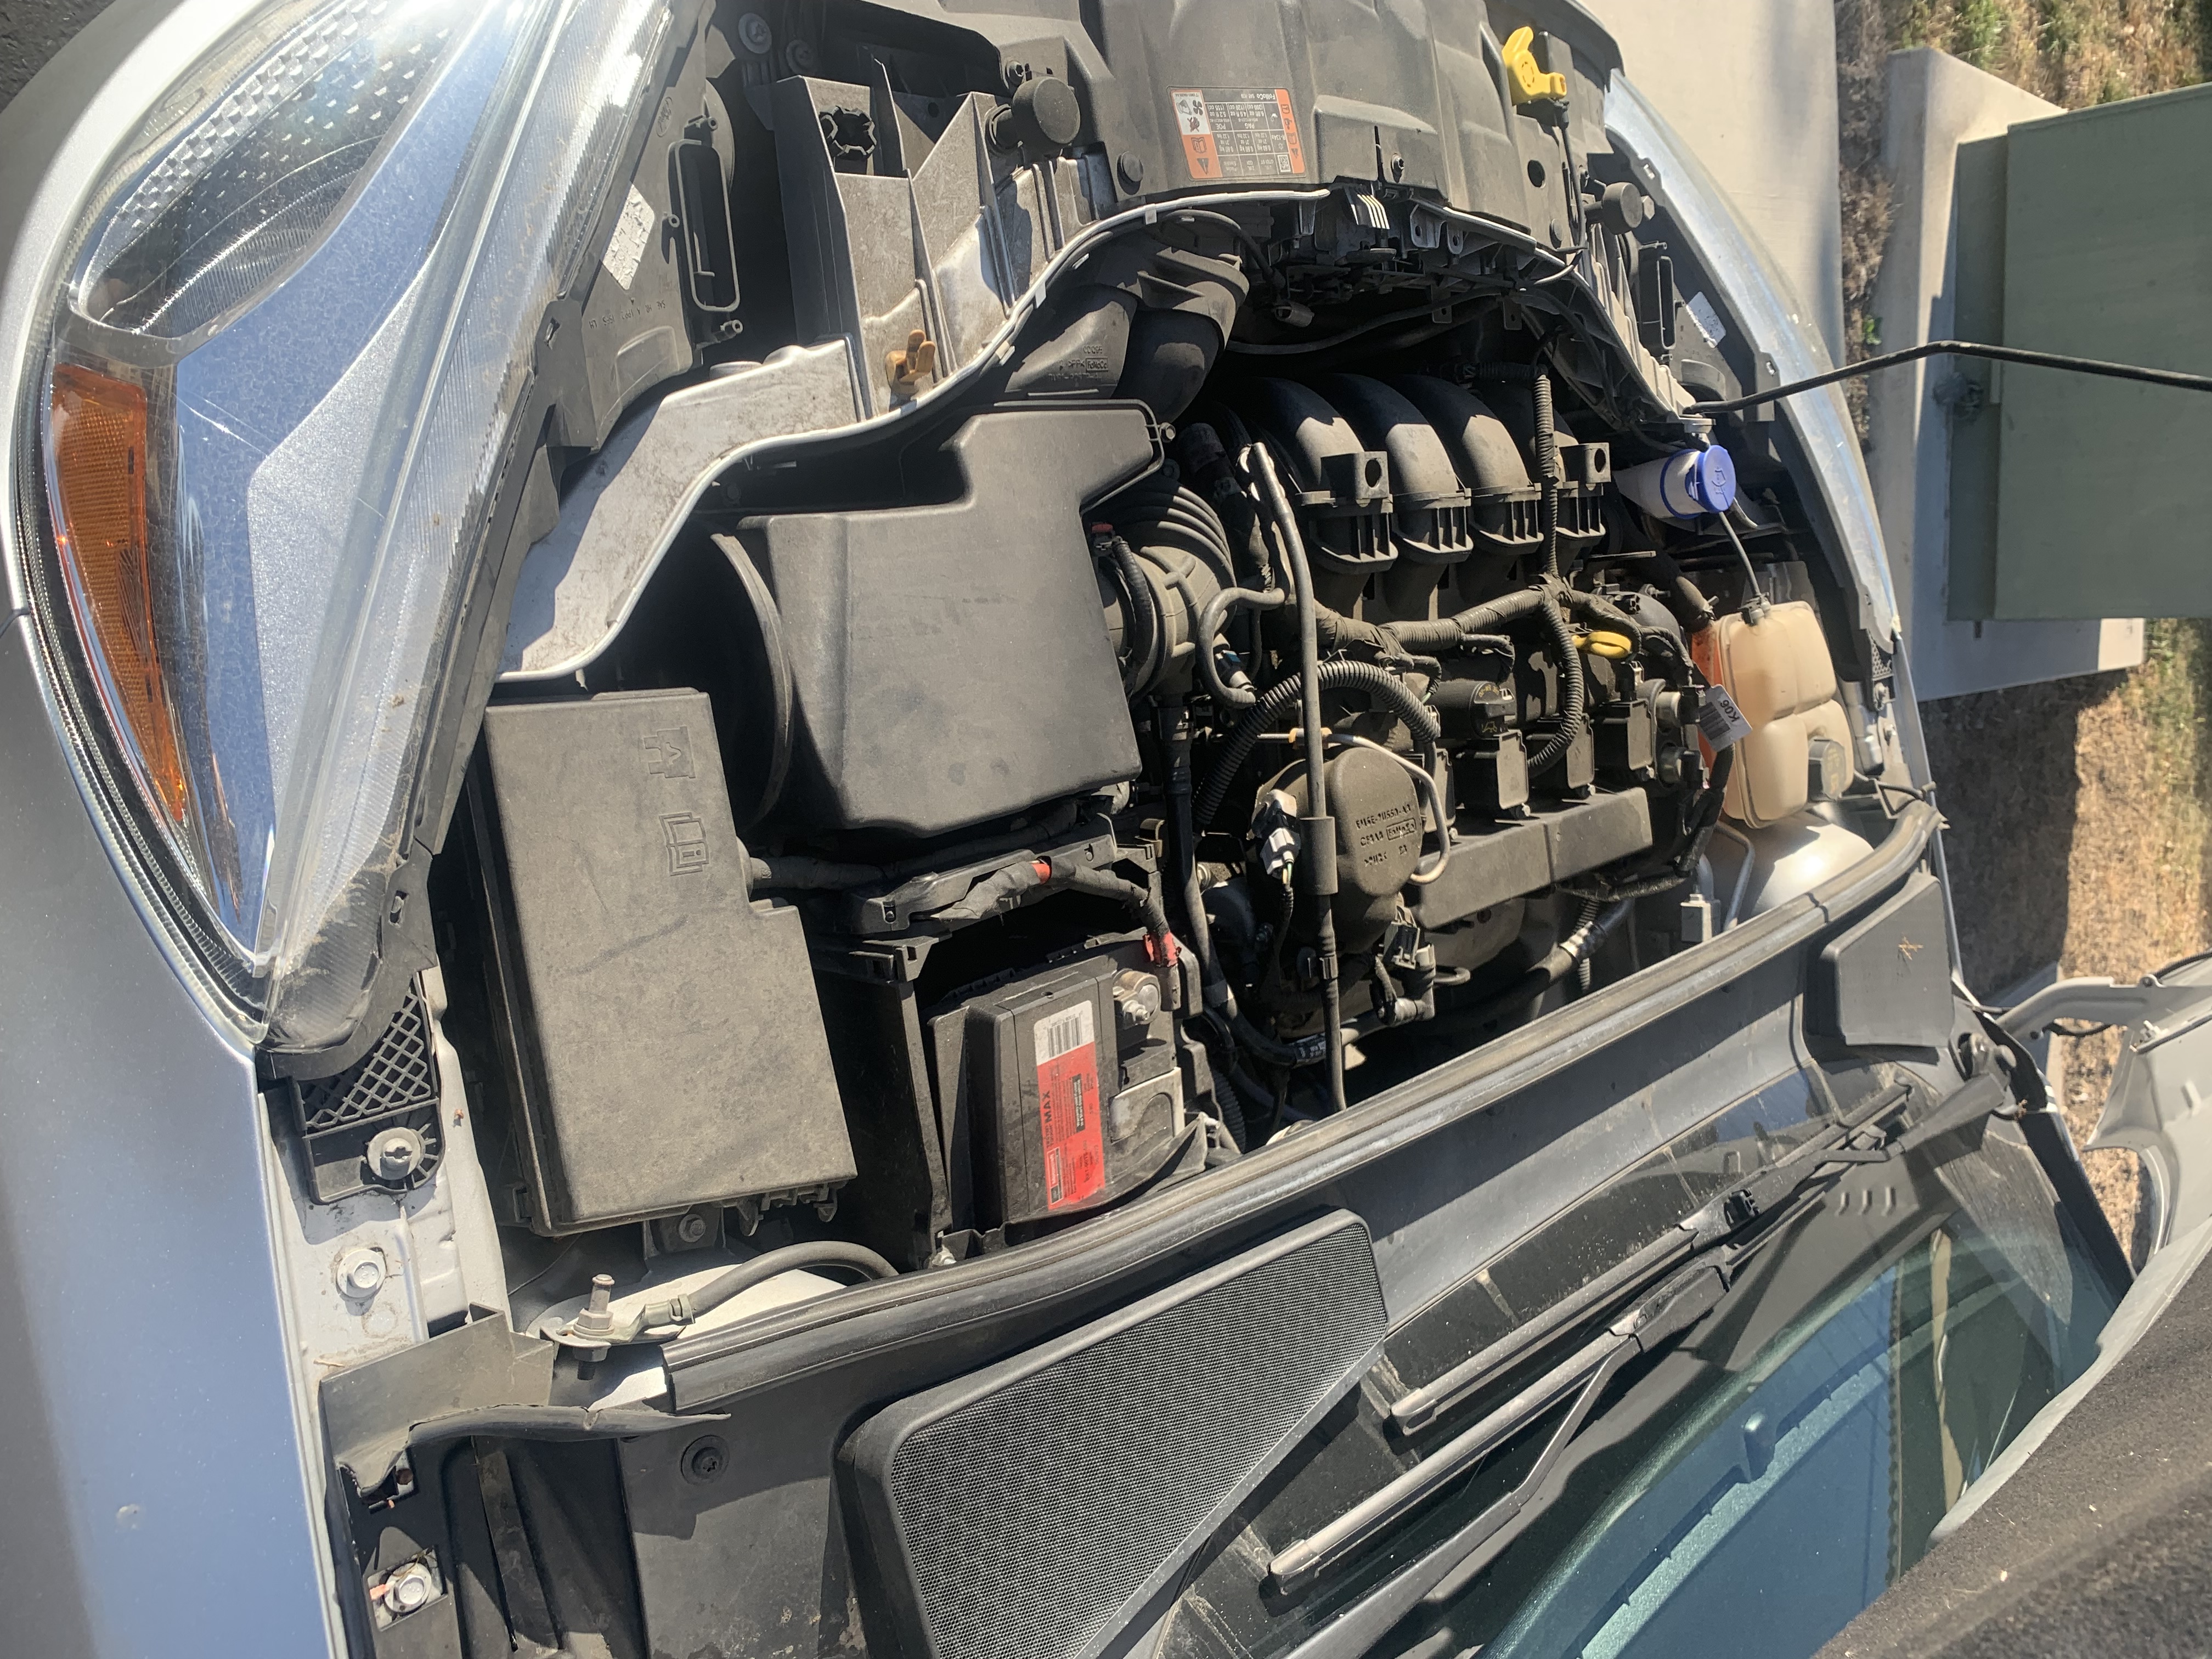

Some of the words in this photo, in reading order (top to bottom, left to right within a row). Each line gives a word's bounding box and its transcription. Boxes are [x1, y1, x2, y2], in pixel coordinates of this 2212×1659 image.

[1218, 144, 1225, 153] kg
[657, 300, 666, 311] SAE
[589, 320, 597, 329] LH
[1087, 360, 1107, 369] FoMoCo
[1720, 699, 1740, 723] K06
[1042, 1090, 1052, 1124] MAX
